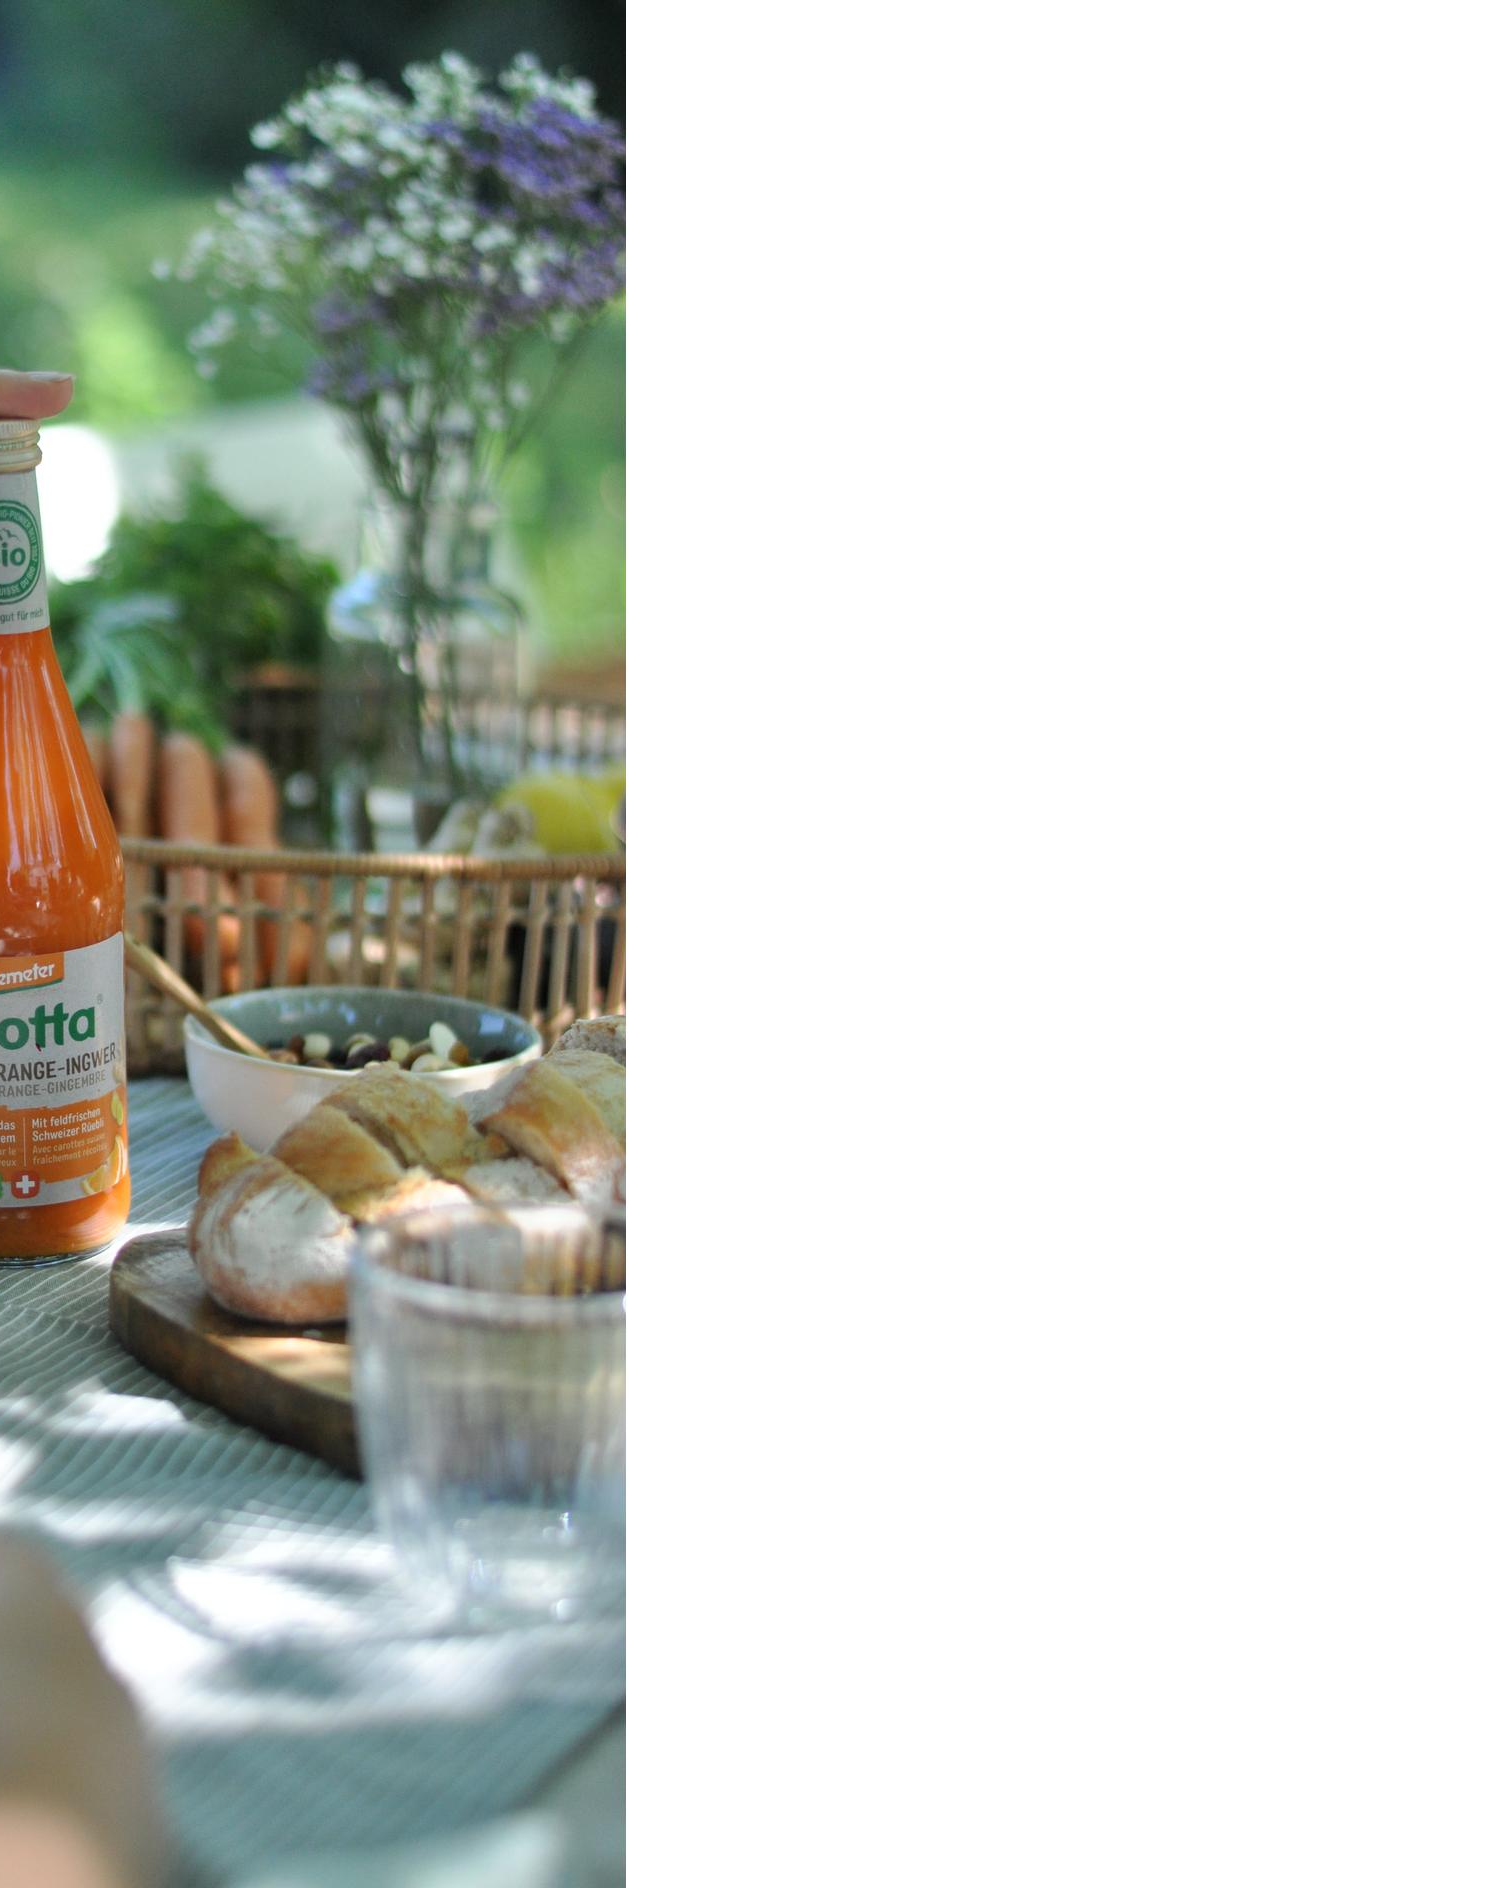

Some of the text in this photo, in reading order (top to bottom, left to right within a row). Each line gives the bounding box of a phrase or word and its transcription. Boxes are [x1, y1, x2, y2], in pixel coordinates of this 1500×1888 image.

[0, 612, 14, 624] gut
[16, 610, 28, 620] für
[31, 1107, 101, 1129] Mit feldfrischen
[32, 1126, 79, 1142] Schweizer
[8, 1146, 17, 1156] le
[33, 1144, 52, 1154] Avec
